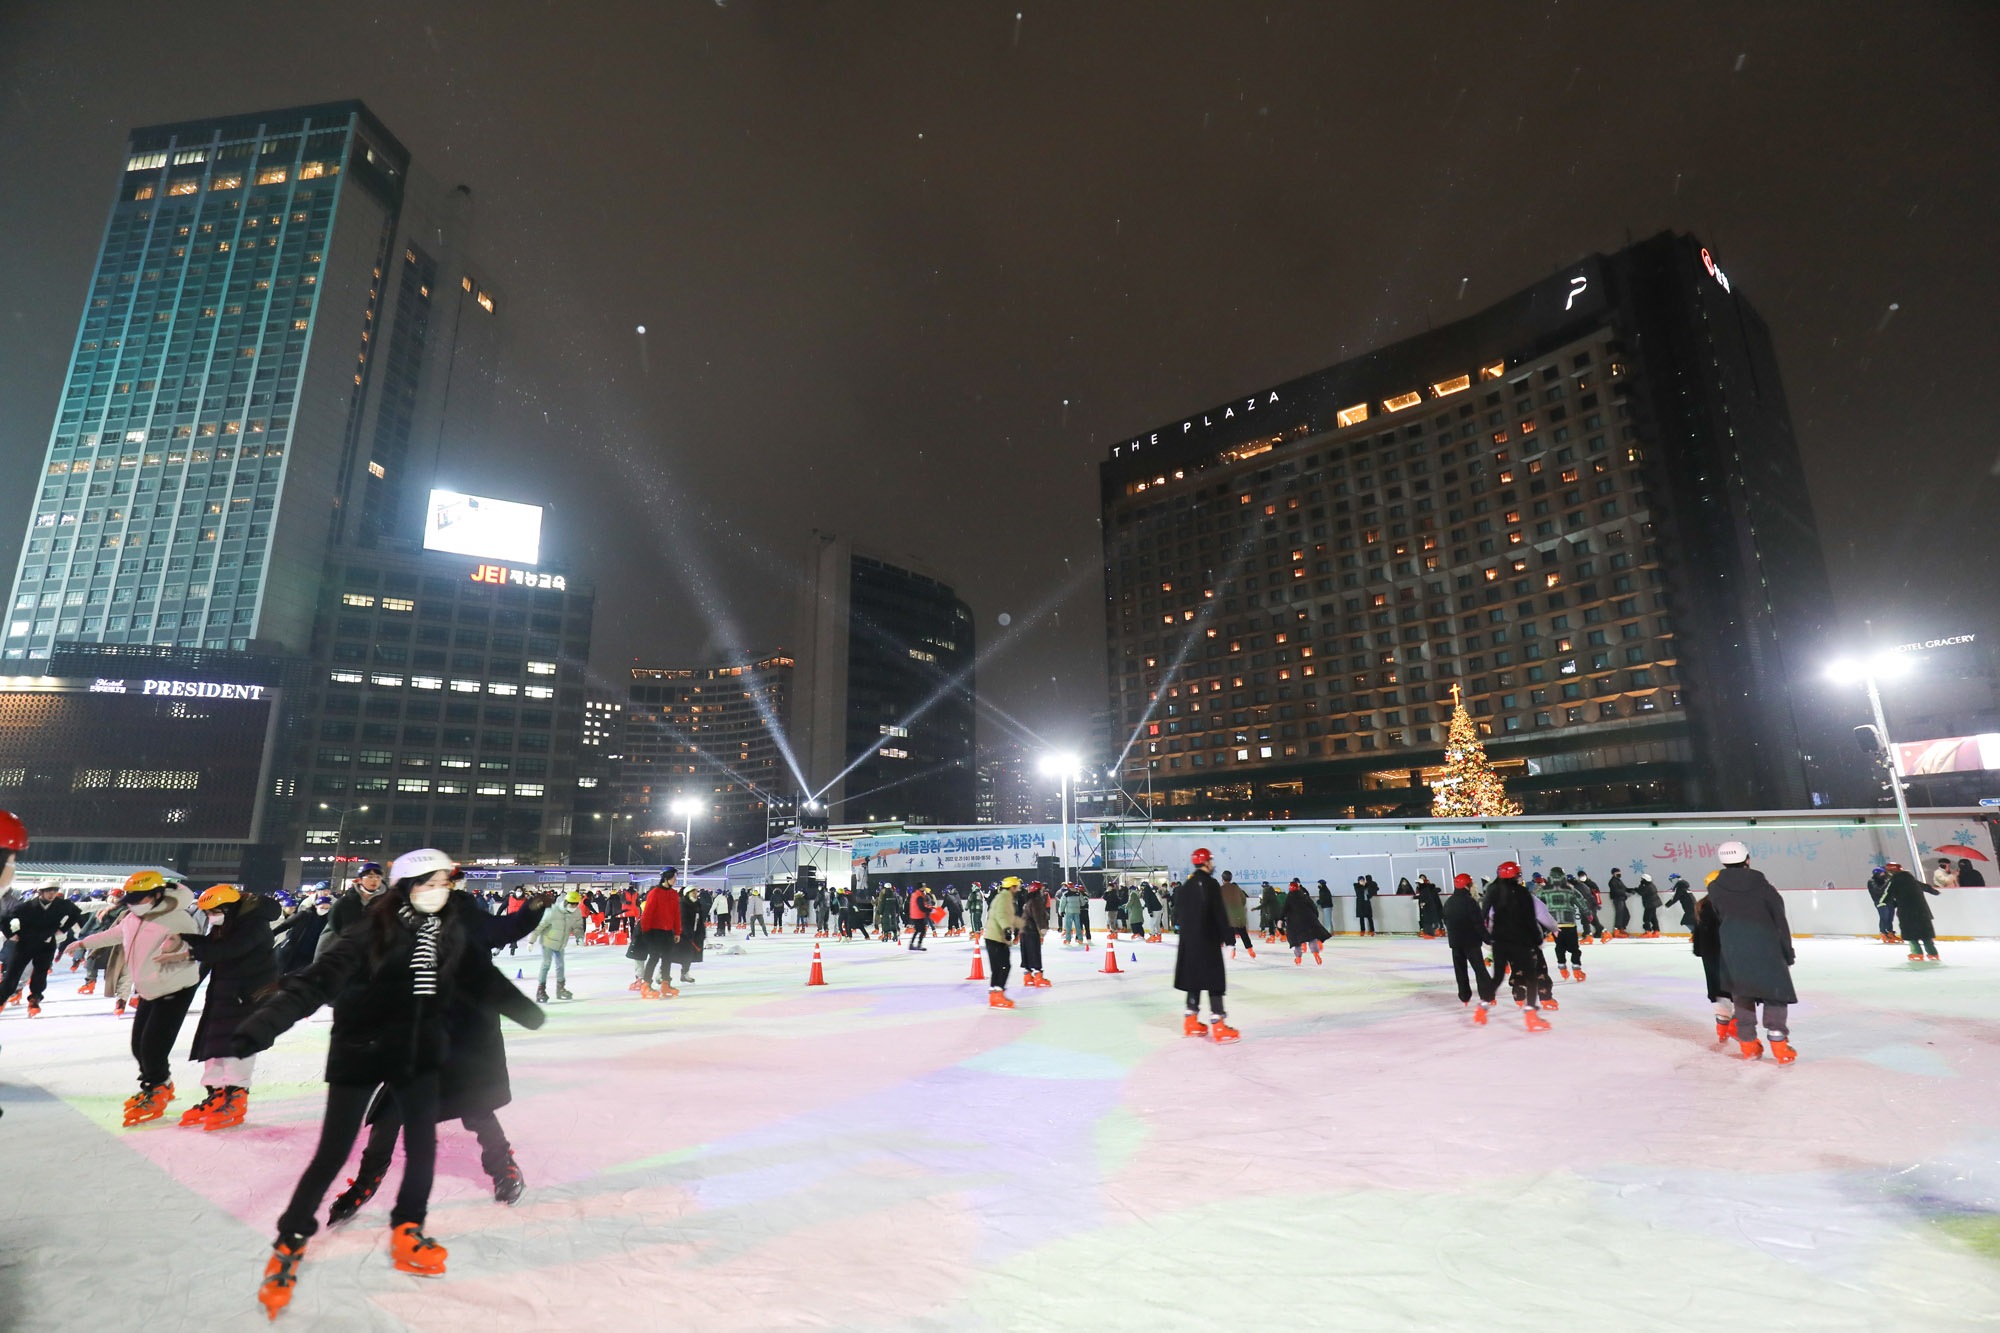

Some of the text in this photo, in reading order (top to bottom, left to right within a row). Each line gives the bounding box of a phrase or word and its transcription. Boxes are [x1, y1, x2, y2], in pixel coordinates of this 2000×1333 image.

[1113, 391, 1279, 458] THE PLAZA
[470, 564, 566, 591] JEI 재능교육
[1889, 634, 1975, 653] HOTEL GRACERY
[142, 679, 264, 700] PRESIDENT
[898, 832, 1045, 855] 서울광장 스케이트장 개장식
[1419, 835, 1485, 847] 기계실 Machine
